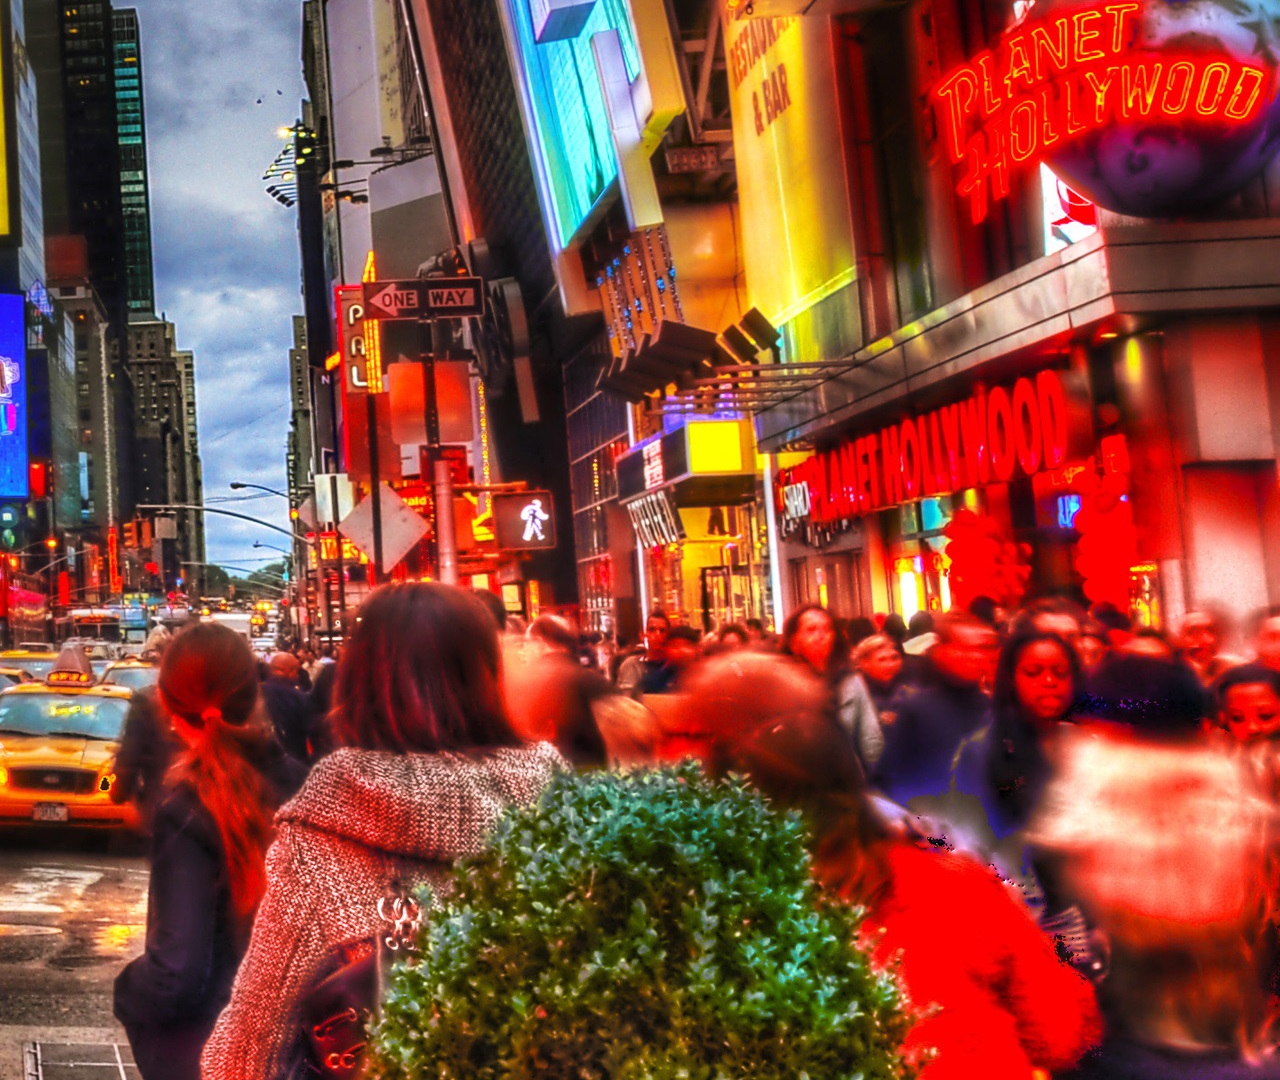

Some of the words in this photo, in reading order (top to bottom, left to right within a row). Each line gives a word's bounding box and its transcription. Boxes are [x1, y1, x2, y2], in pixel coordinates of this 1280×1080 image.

[763, 63, 791, 128] BAR
[938, 3, 1139, 163] PLANET
[957, 61, 1266, 224] HOLLYWOOD
[382, 289, 416, 307] ONE
[431, 289, 467, 307] WAY
[807, 433, 881, 522] PLANET
[880, 368, 1067, 505] HOLLYWOOD
